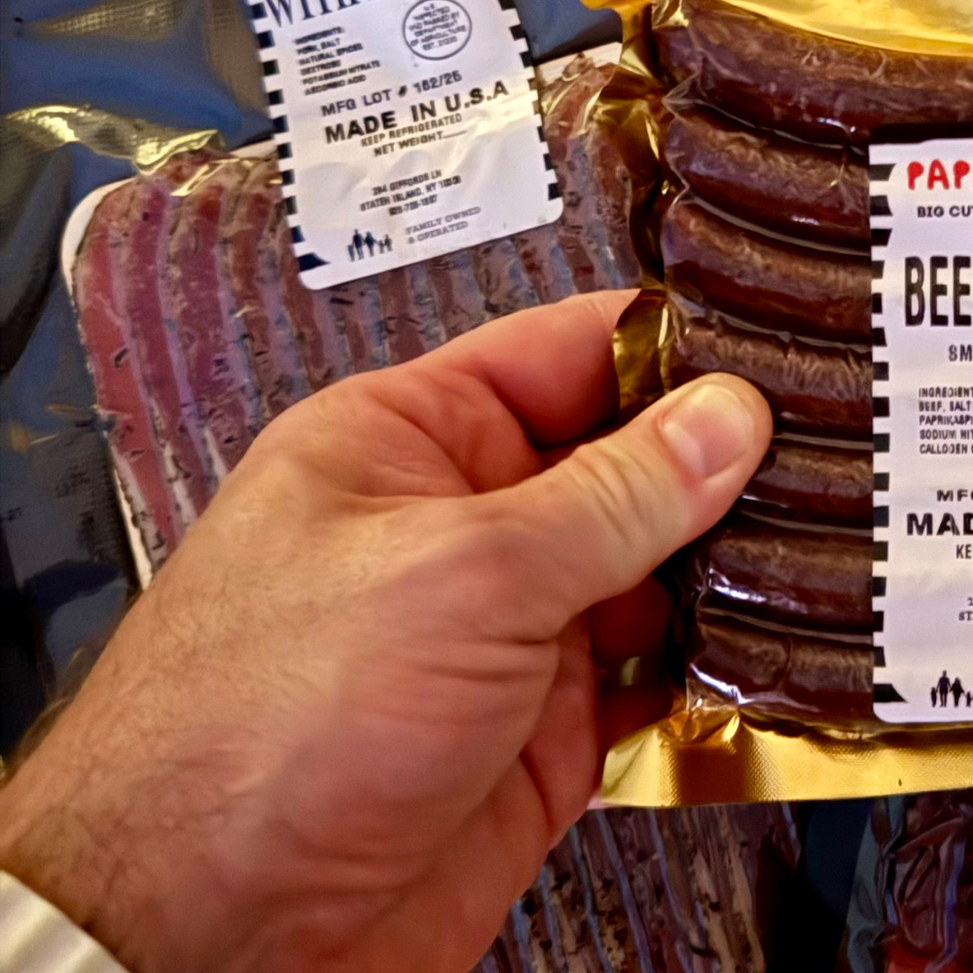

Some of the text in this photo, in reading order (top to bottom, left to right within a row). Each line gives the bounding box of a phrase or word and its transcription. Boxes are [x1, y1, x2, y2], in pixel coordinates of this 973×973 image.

[321, 99, 356, 117] MFG
[364, 89, 392, 106] LOT
[325, 81, 509, 144] MADE IN U.S.A
[361, 114, 461, 147] KEEP REFRIGERATED
[374, 143, 395, 156] NET
[360, 197, 390, 211] STATEN
[426, 183, 436, 192] NY
[917, 206, 944, 217] BIG
[406, 218, 441, 234] FAMILY
[418, 221, 468, 242] OPERATED
[950, 401, 971, 411] SALT
[920, 429, 956, 439] SODIUM
